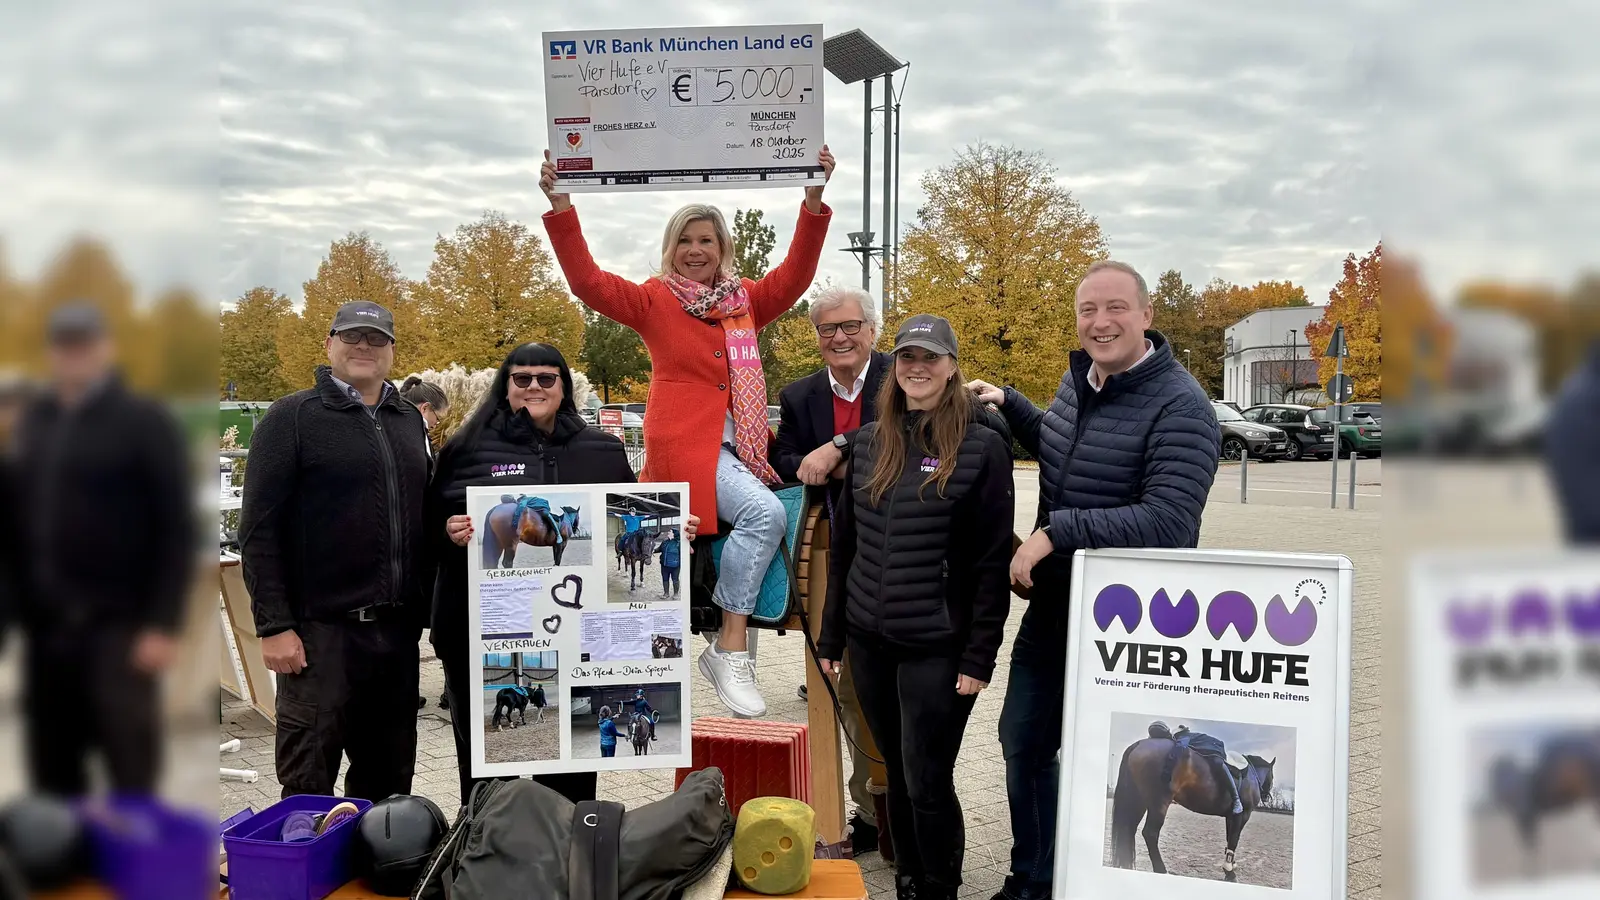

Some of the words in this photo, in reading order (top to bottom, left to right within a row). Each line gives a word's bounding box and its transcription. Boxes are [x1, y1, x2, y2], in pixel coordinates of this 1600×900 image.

[583, 40, 606, 55] VR
[612, 37, 654, 54] Bank
[659, 35, 738, 52] München
[744, 34, 785, 50] Land
[789, 34, 813, 49] eG
[577, 60, 605, 82] Vier
[610, 58, 641, 81] Hufe
[577, 79, 642, 98] Parsdorf
[671, 74, 692, 103] €
[750, 110, 796, 121] MÜNCHEN
[593, 122, 623, 132] FROHES
[623, 121, 643, 131] HERZ
[748, 120, 794, 133] Parsdorf
[767, 135, 807, 148] Oktober
[772, 147, 806, 160] 2025
[491, 470, 507, 478] VIER
[920, 465, 935, 473] VIER
[486, 567, 553, 579] GEBORGENHEIT
[483, 638, 552, 652] VERTRAUEN
[1094, 639, 1191, 678] VIER
[1200, 647, 1310, 687] HUFE
[571, 666, 591, 679] Das
[592, 667, 615, 679] Pferd
[622, 665, 643, 676] Dein
[645, 664, 674, 677] Spiegel
[1094, 676, 1124, 688] Verein
[1125, 681, 1141, 689] zur
[1143, 681, 1191, 695] Förderung
[1193, 685, 1270, 700] therapeutischen
[1272, 690, 1310, 703] Reitens
